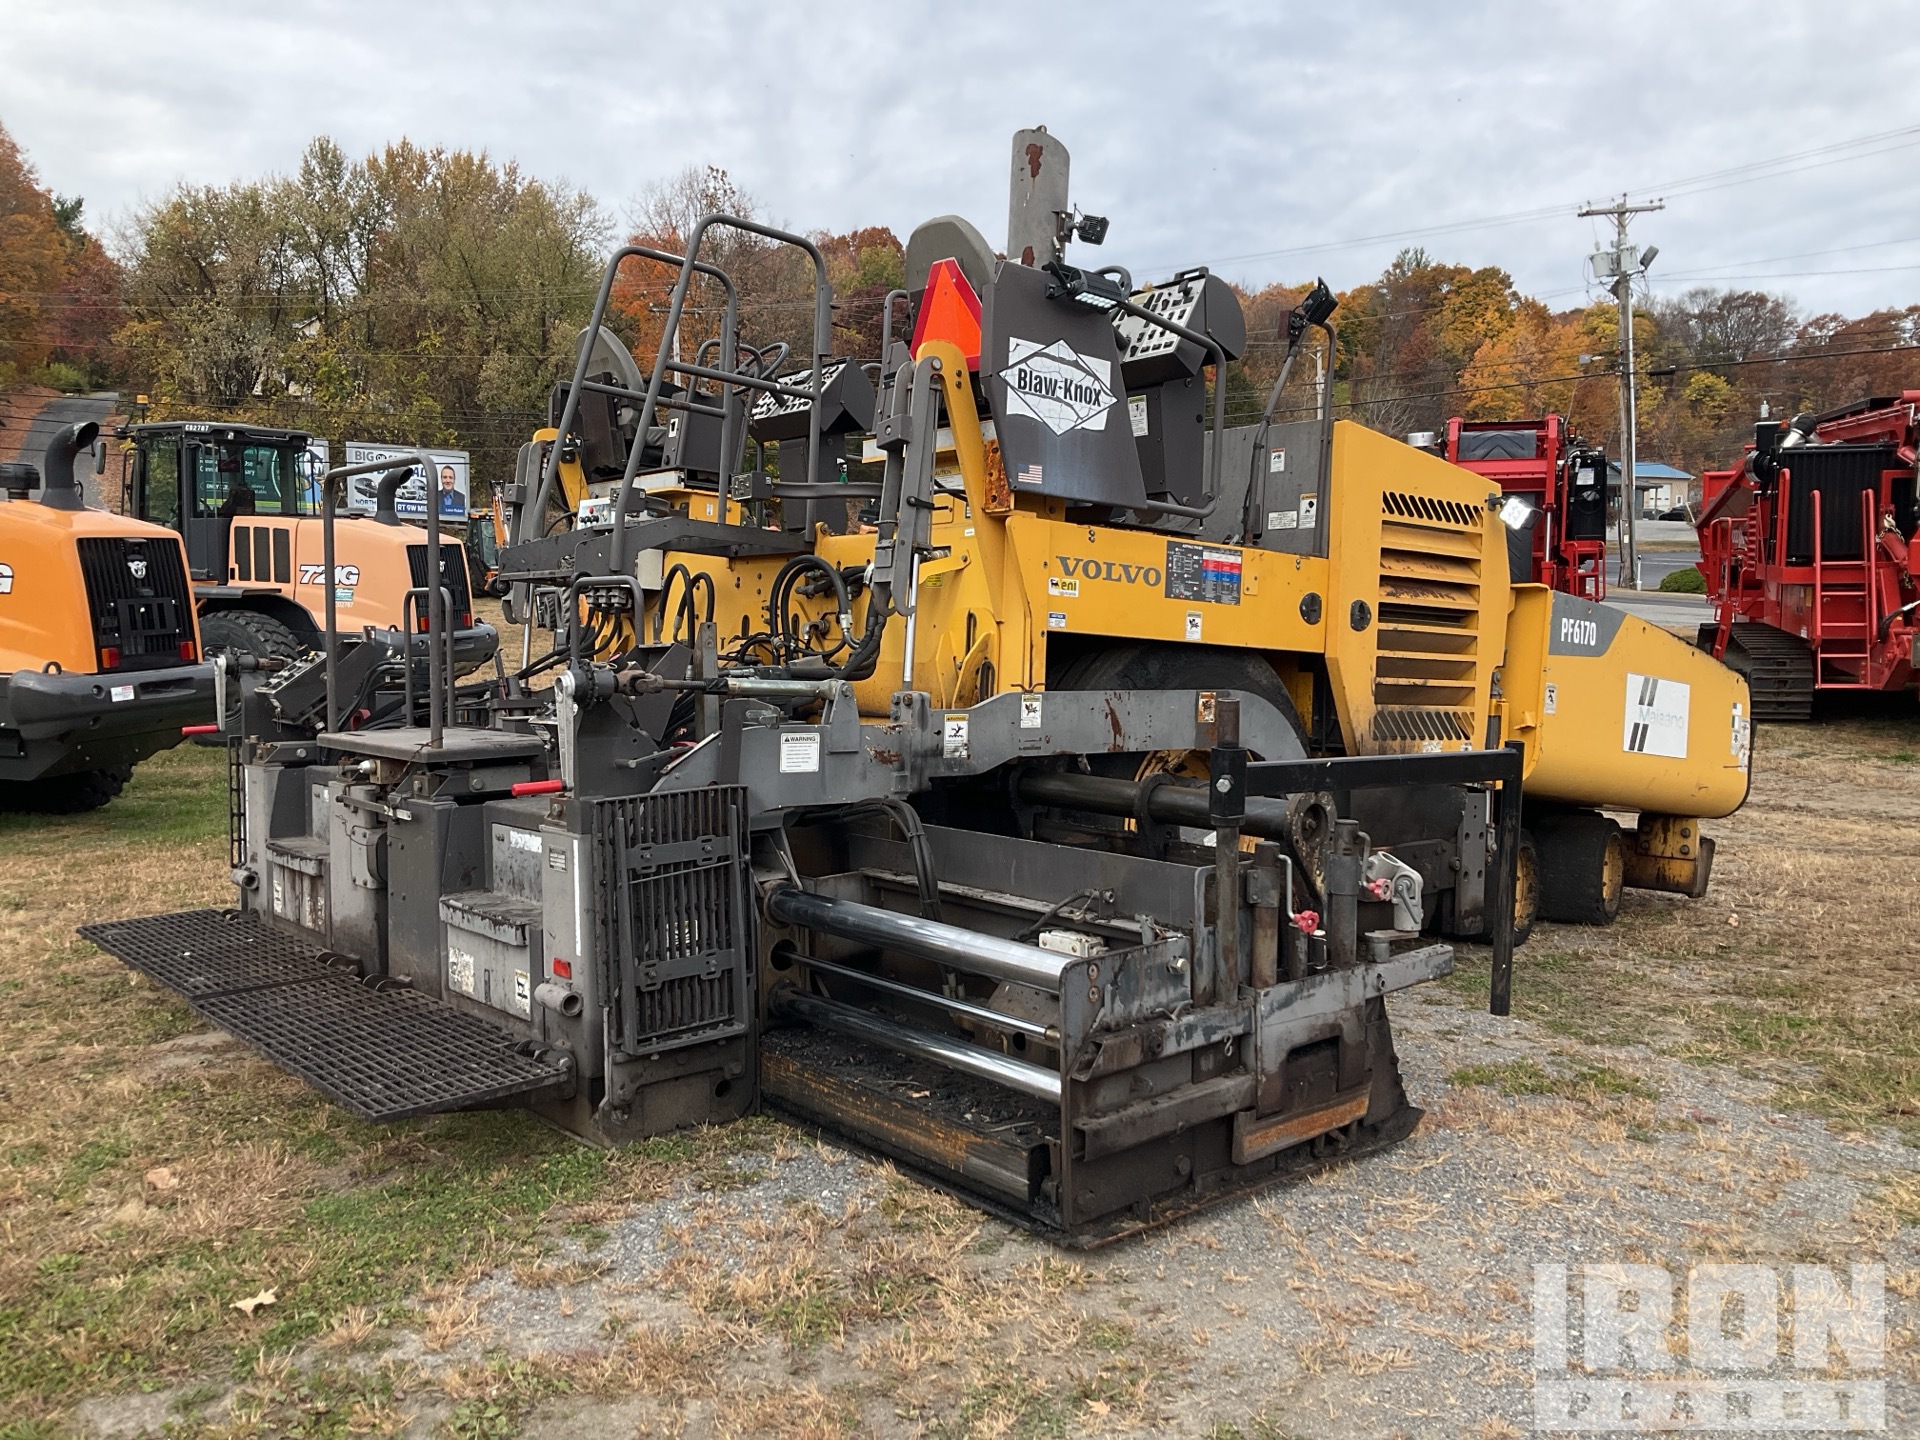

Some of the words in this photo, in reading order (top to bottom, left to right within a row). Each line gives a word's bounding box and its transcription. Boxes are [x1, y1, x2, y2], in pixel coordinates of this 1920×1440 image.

[354, 450, 374, 462] BIG
[355, 499, 376, 507] NORTH
[1056, 555, 1161, 587] VOLVO
[1061, 580, 1077, 592] eni
[1561, 617, 1597, 647] PF6170
